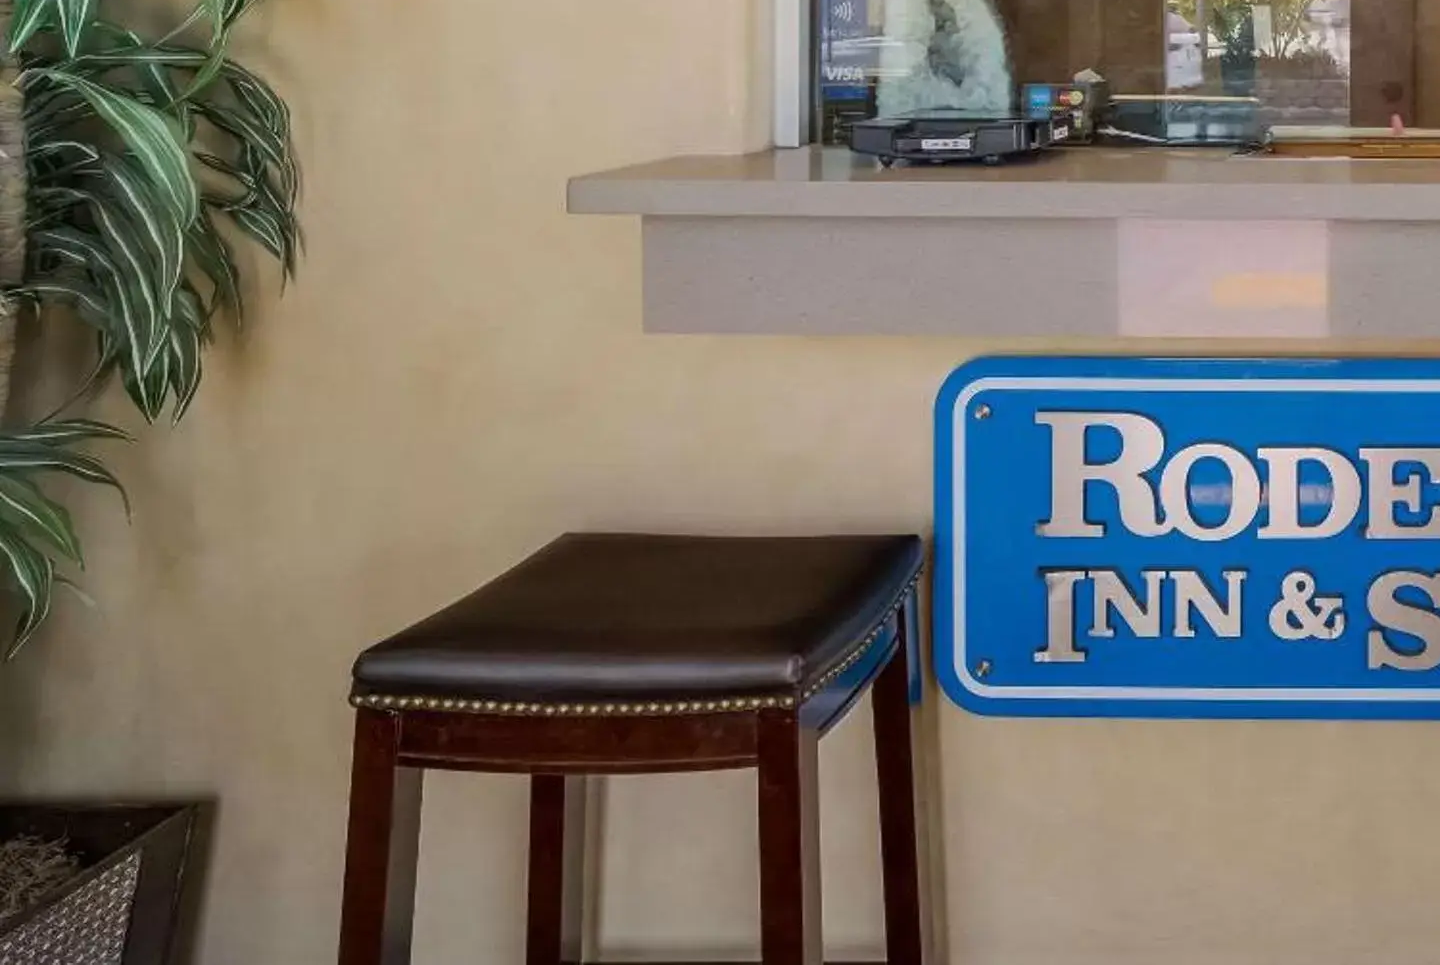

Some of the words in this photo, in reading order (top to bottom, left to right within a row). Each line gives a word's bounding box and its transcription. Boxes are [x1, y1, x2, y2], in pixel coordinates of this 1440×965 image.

[825, 66, 865, 81] VISA
[1033, 570, 1247, 663] INN
[1267, 570, 1346, 641] &
